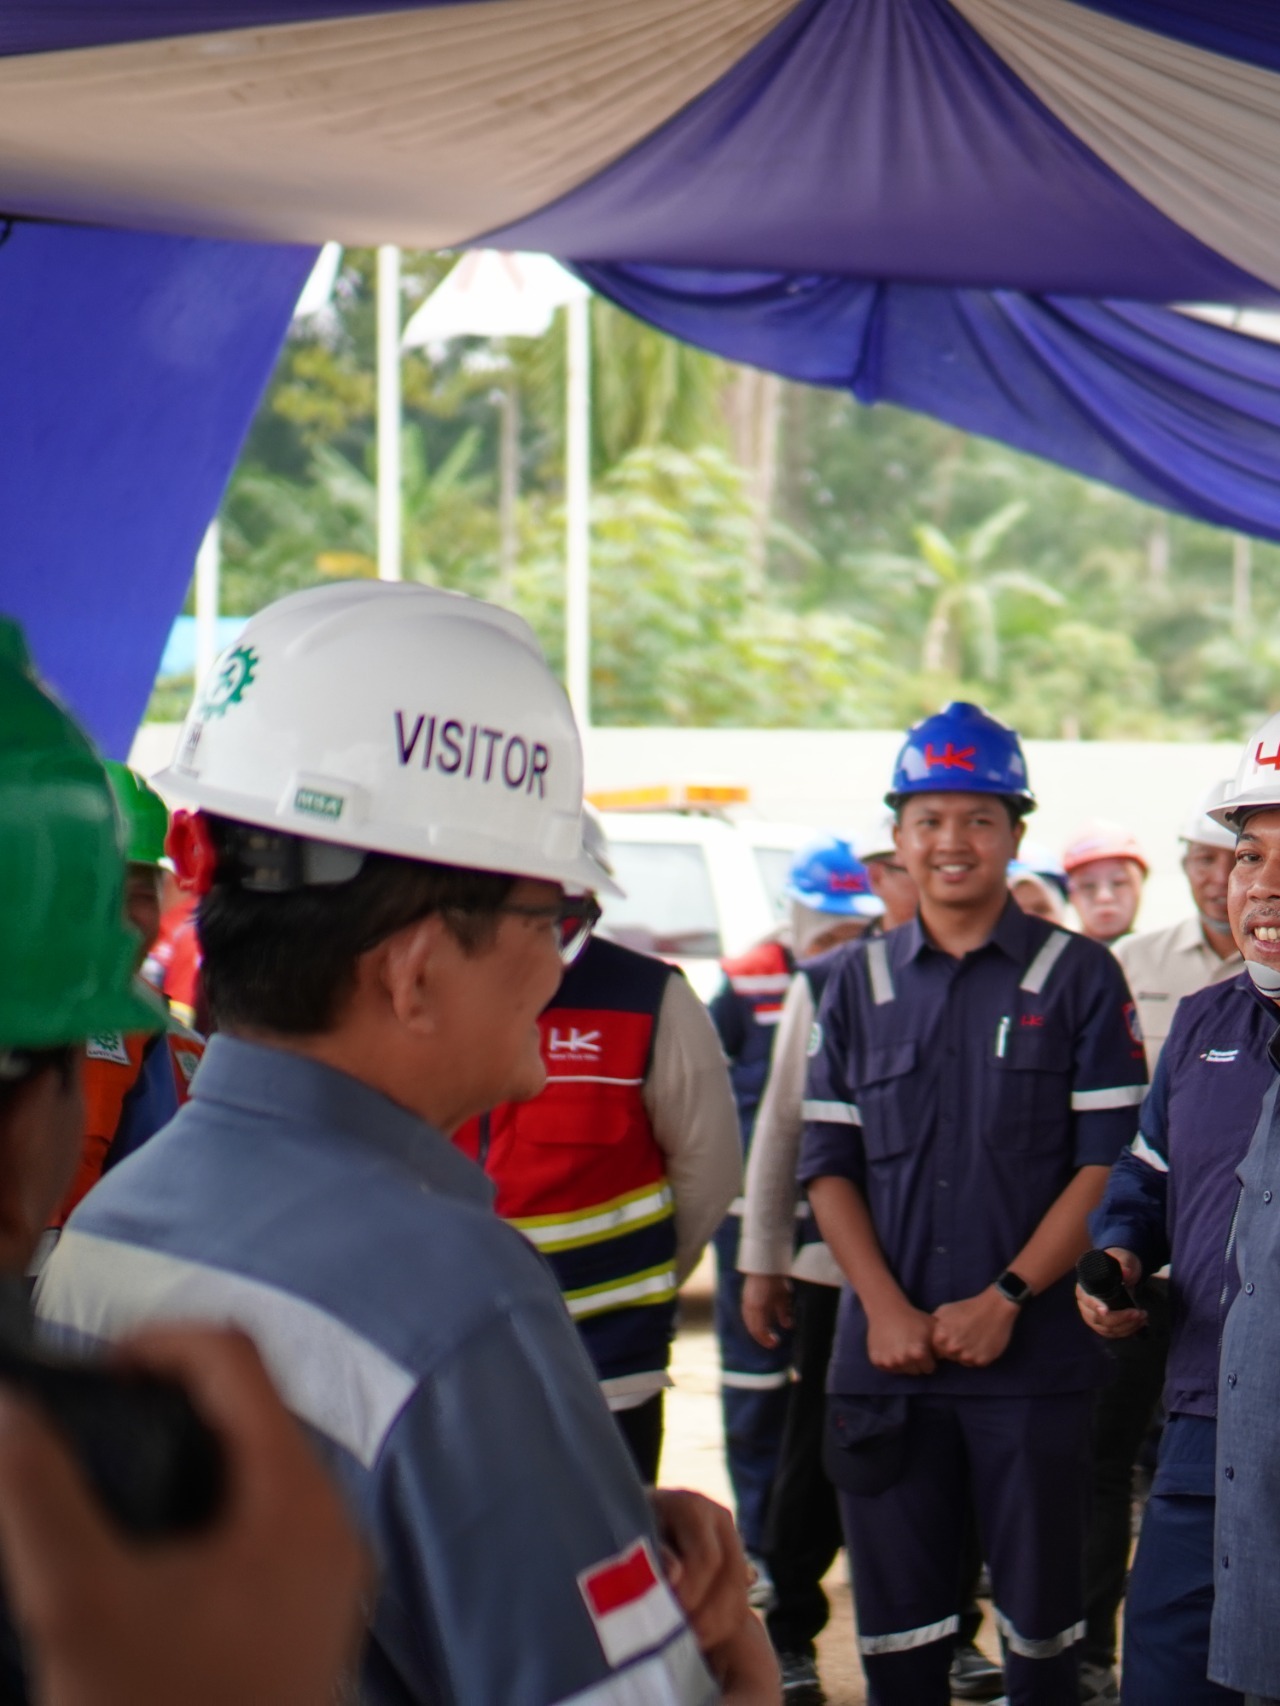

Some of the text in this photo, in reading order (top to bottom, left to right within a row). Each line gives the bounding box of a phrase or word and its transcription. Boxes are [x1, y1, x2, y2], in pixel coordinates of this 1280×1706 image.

[394, 710, 549, 799] VISITOR
[925, 744, 976, 771] HK
[549, 1027, 602, 1053] HK
